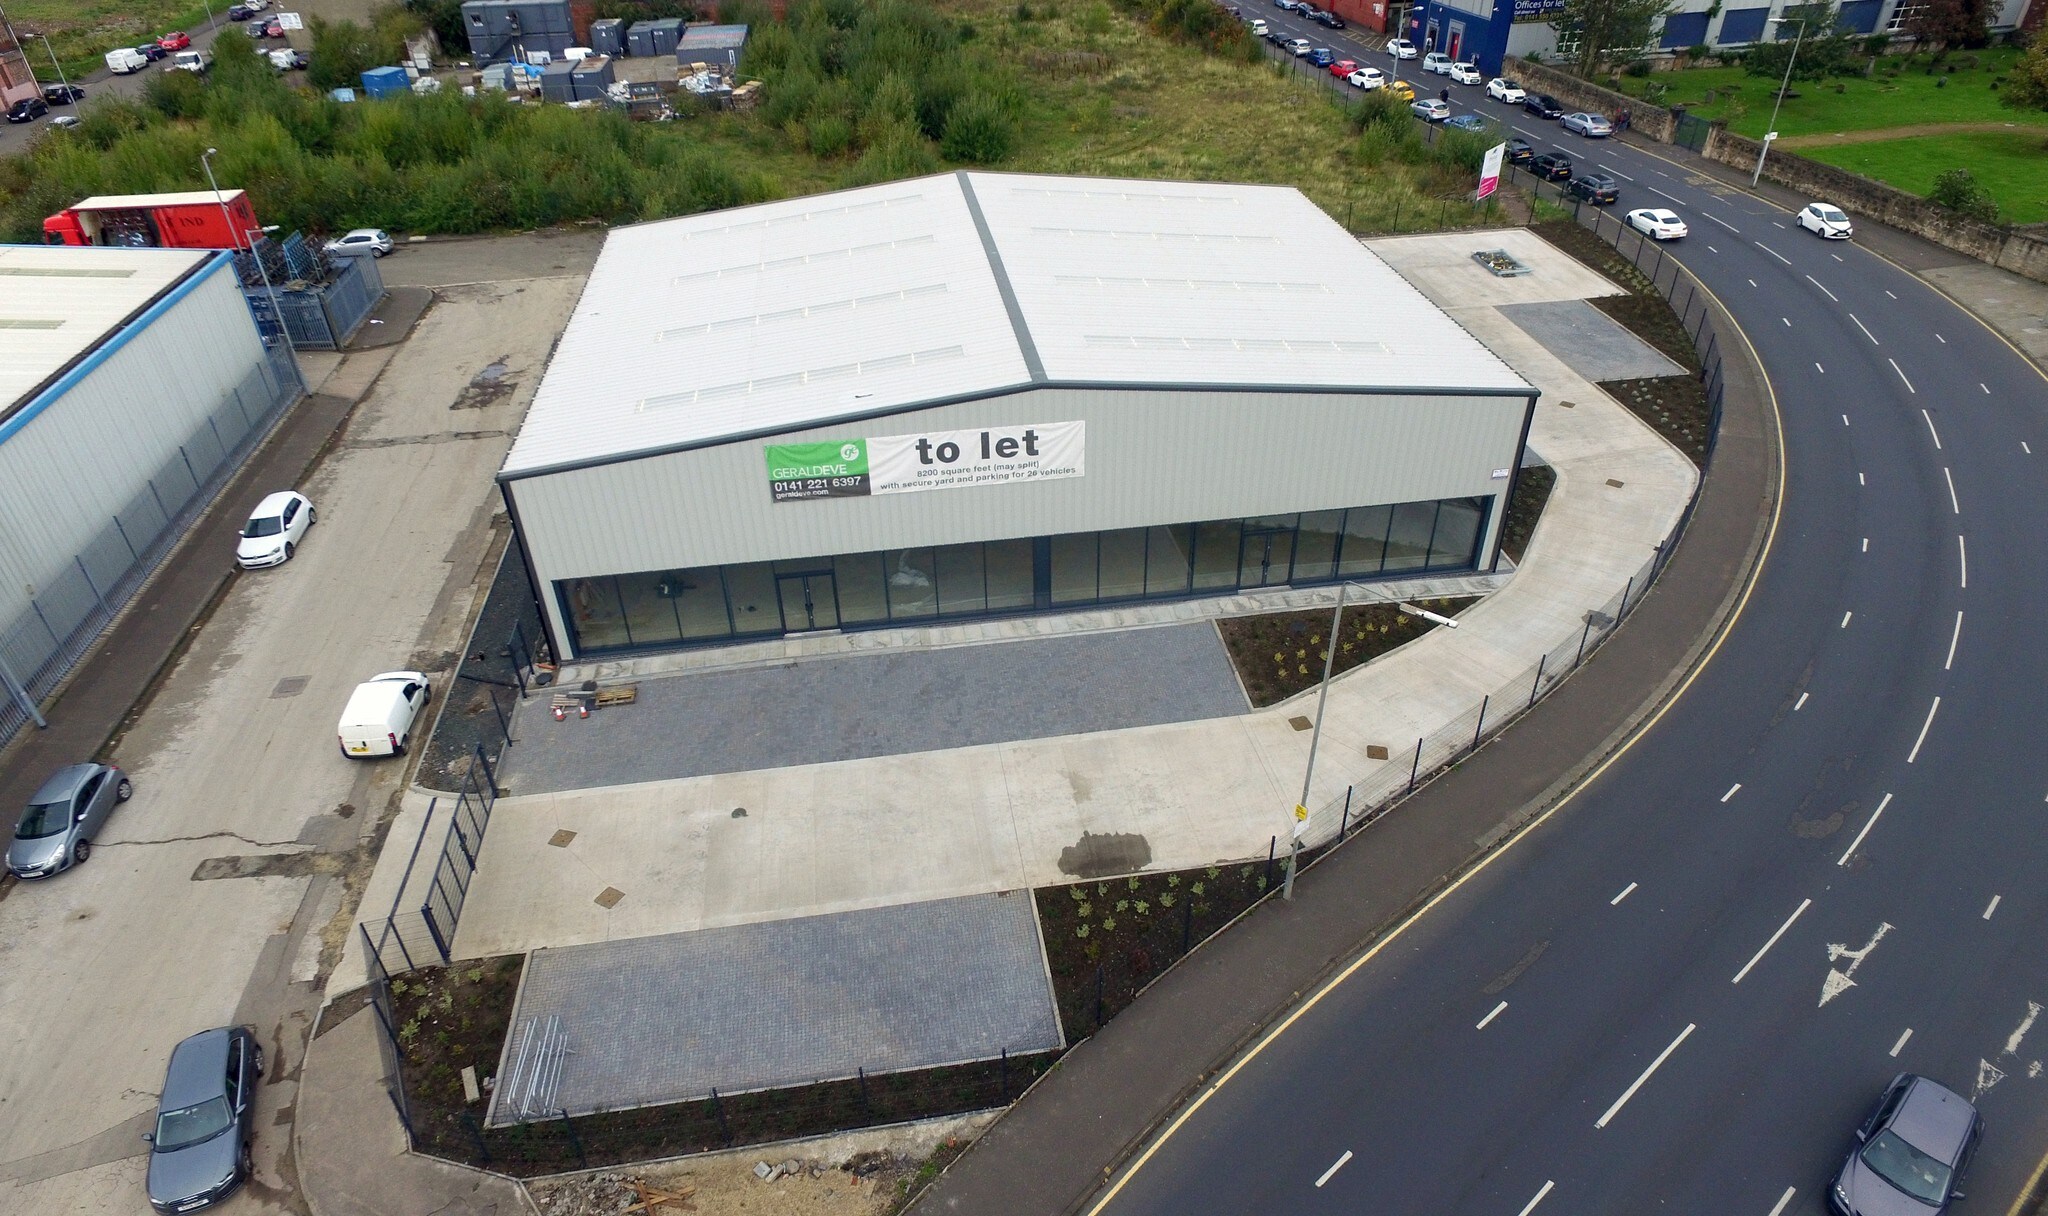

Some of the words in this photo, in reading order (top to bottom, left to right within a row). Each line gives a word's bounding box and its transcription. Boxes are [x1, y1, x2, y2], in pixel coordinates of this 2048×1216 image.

[1515, 1, 1541, 9] Offices
[915, 438, 960, 465] to
[981, 430, 1039, 459] let
[773, 464, 847, 479] GERALDEVE
[917, 469, 938, 477] 8200
[940, 467, 971, 475] square
[974, 464, 991, 472] feet
[993, 463, 1015, 471] (may
[1017, 460, 1040, 470] split)
[774, 481, 802, 492] 0141
[807, 479, 828, 489] 221
[832, 476, 861, 487] 6397
[880, 481, 899, 490] with
[902, 479, 932, 488] secure
[935, 476, 954, 486] yard
[957, 475, 973, 483] and
[976, 473, 1009, 482] parking
[1040, 467, 1076, 476] vehicles
[776, 488, 829, 499] geraldeve.com
